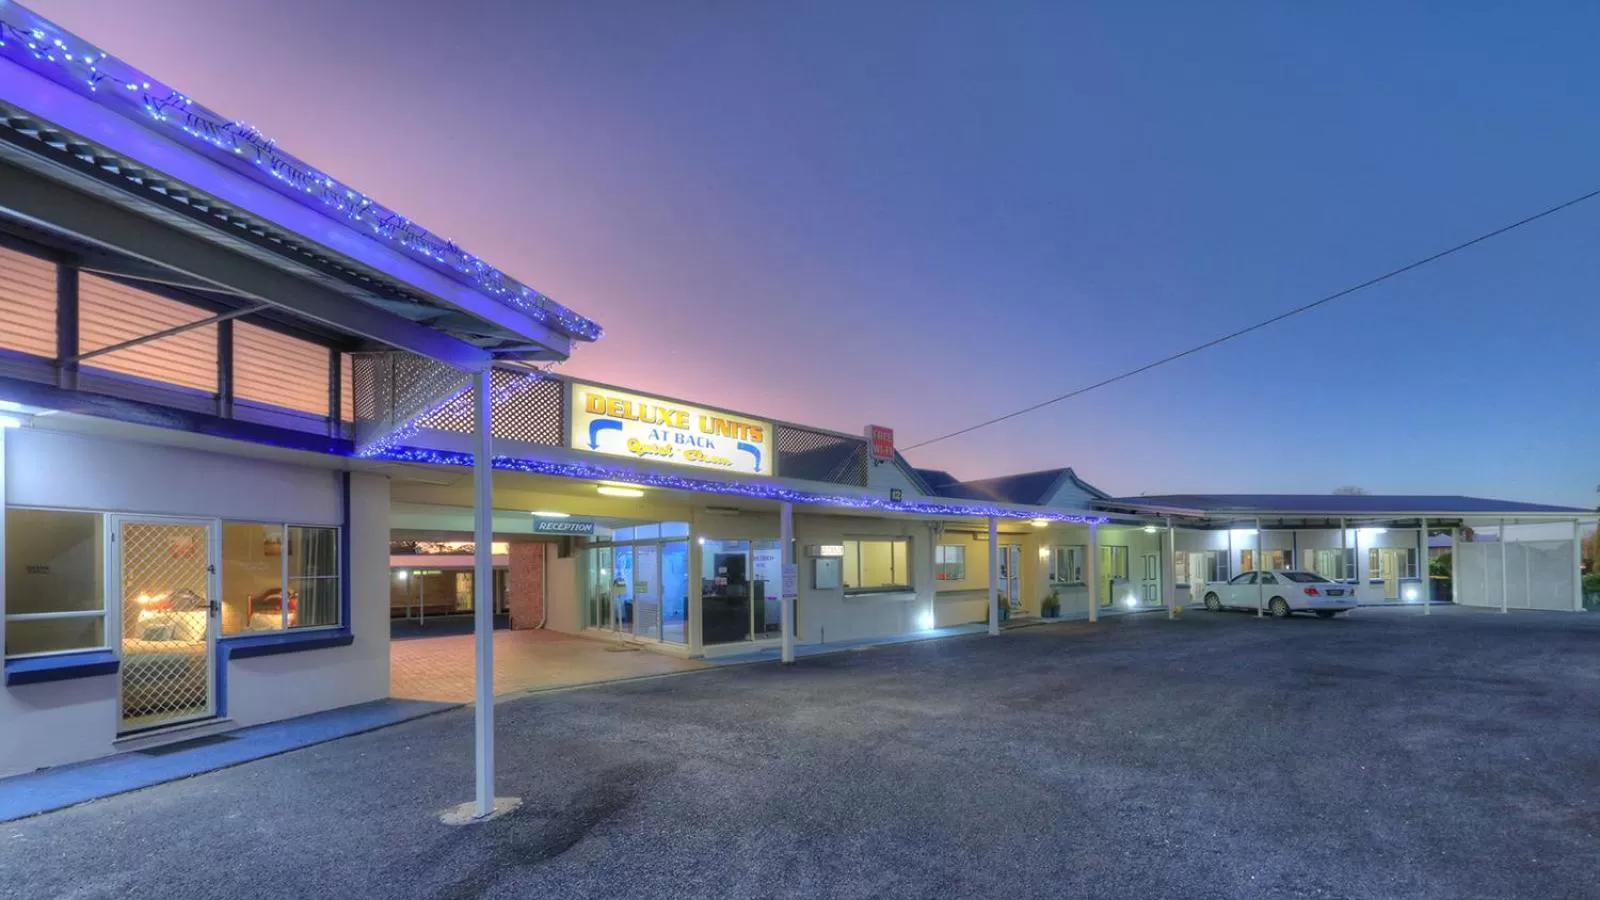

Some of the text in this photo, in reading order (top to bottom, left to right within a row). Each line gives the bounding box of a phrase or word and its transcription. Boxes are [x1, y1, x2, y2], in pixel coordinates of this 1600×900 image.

[585, 392, 764, 443] DELUXE UNITS
[648, 428, 716, 449] AT BACK
[538, 521, 592, 532] RECEPTION
